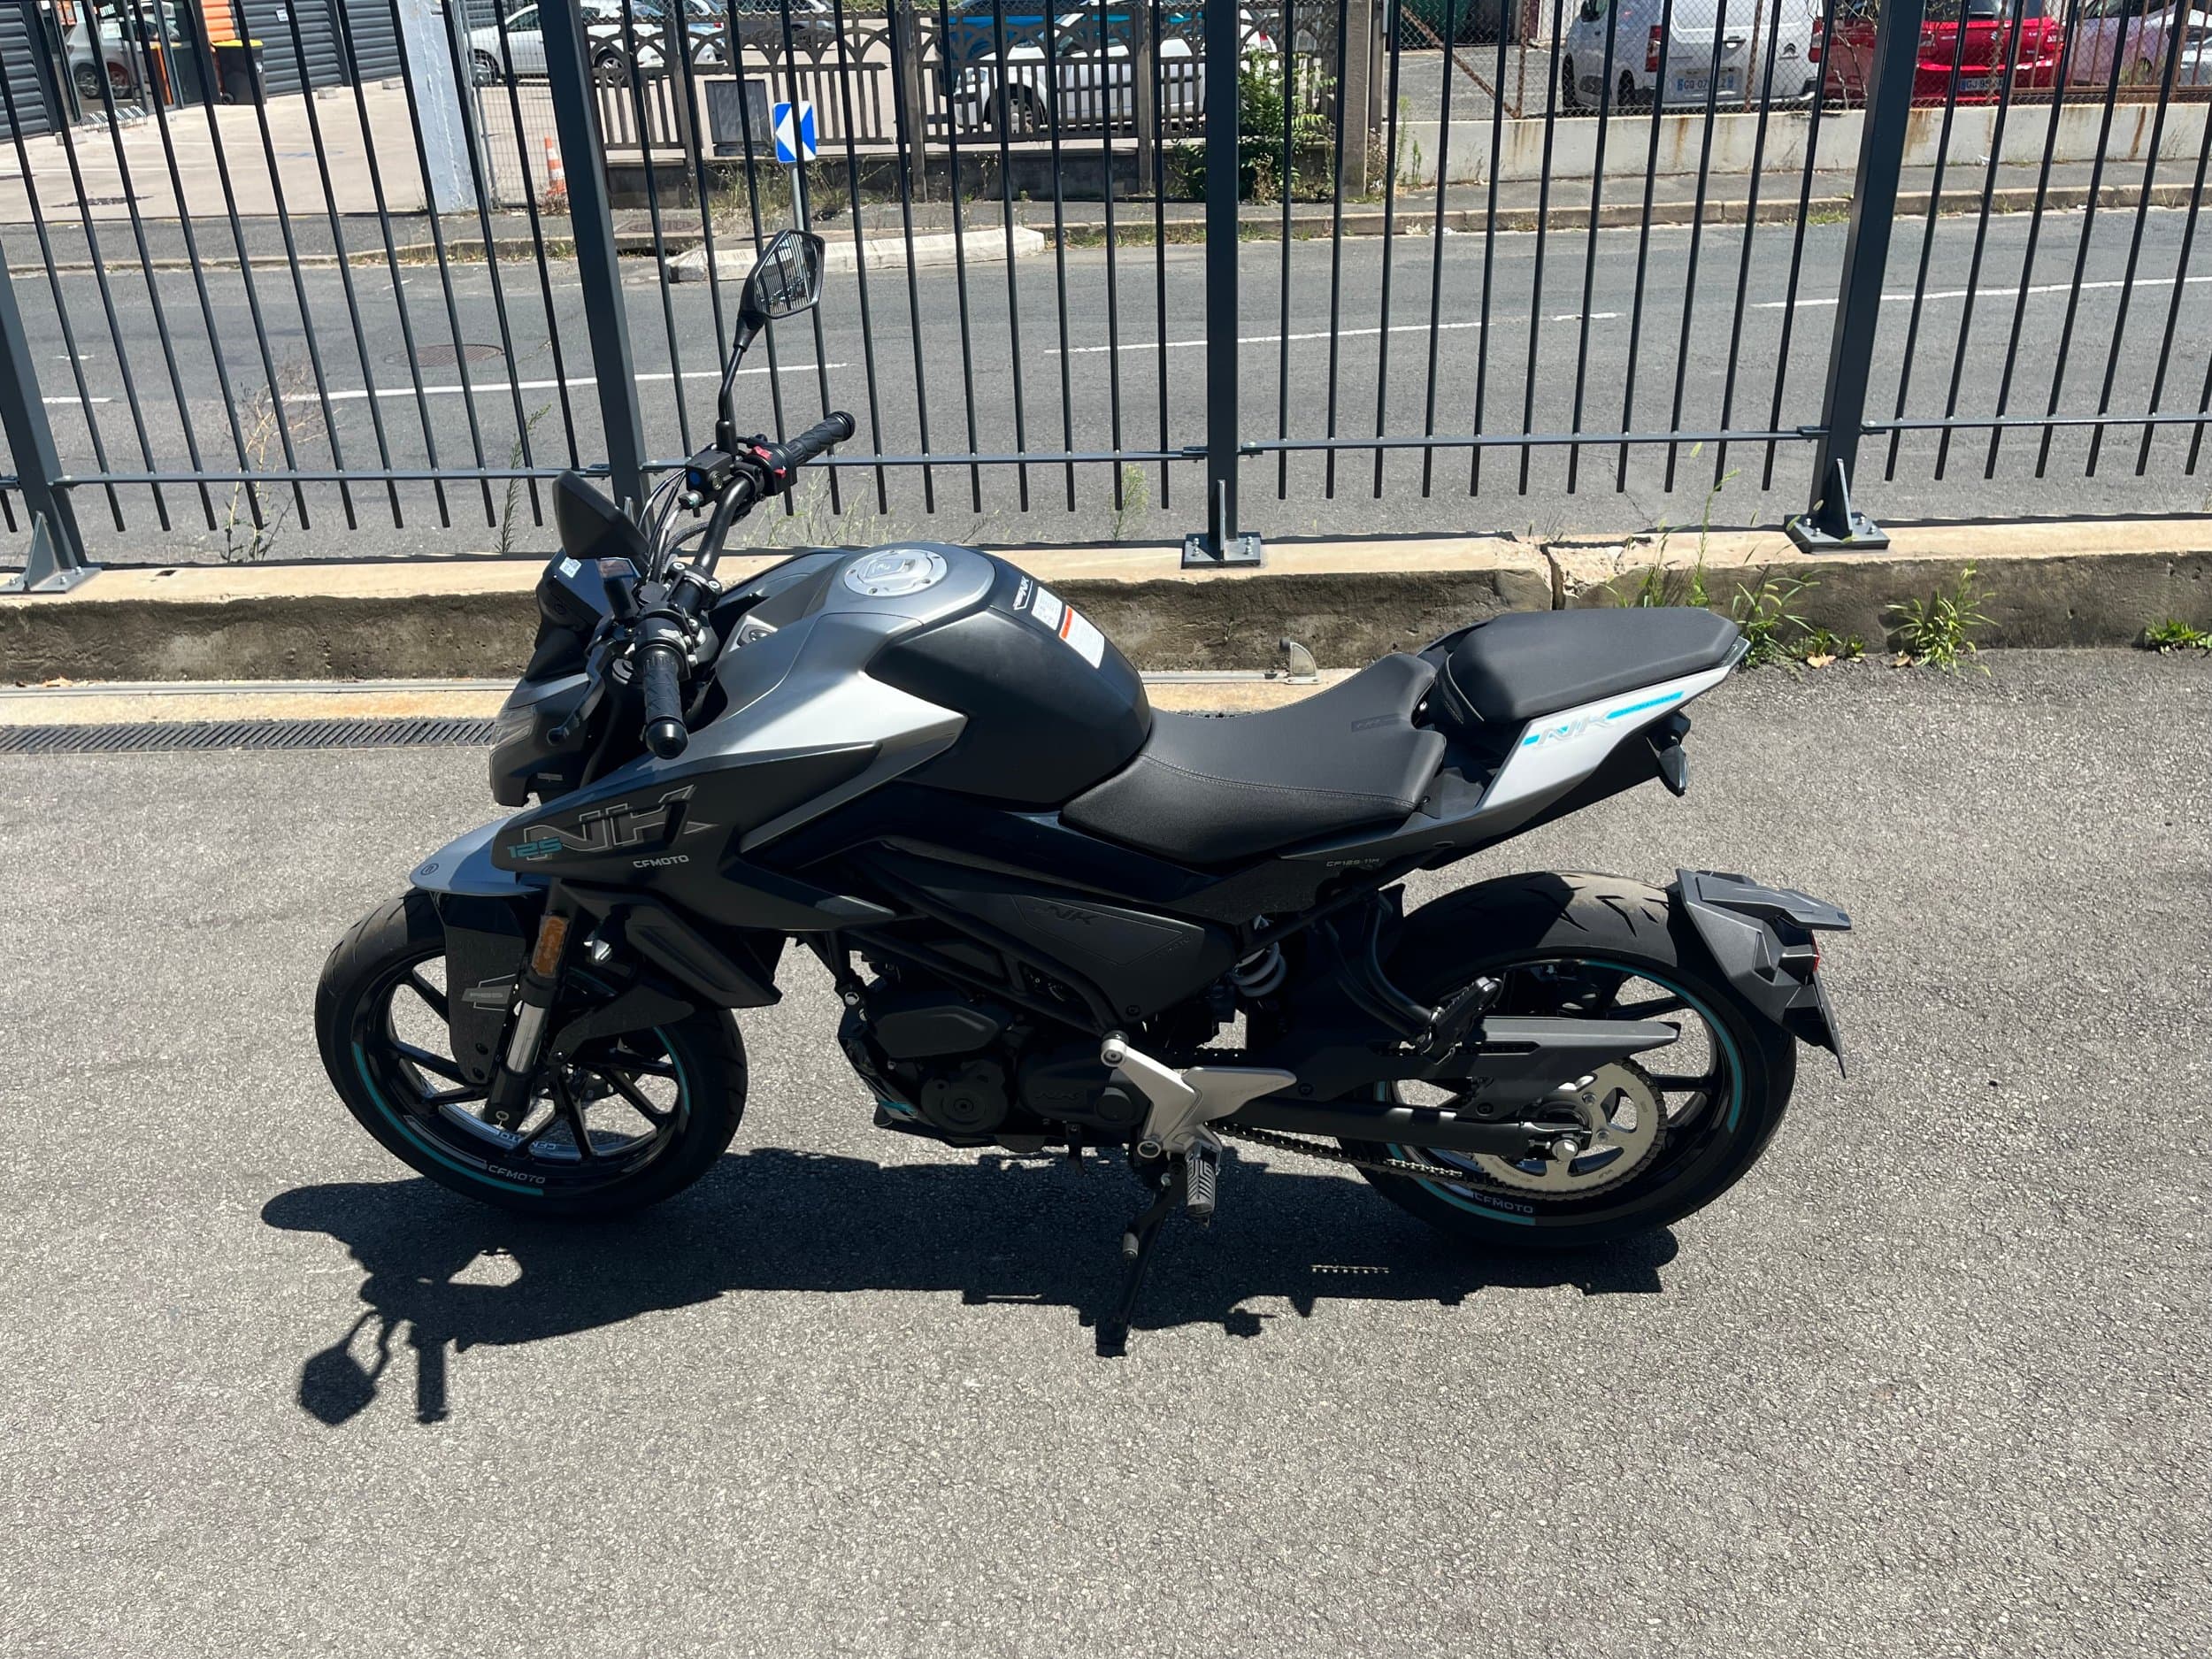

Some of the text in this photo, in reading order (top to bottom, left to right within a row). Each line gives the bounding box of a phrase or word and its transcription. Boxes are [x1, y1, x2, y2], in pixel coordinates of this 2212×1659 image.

[507, 837, 565, 858] 125
[633, 854, 689, 869] CFMOTO
[488, 1164, 546, 1184] CFMOTO
[1475, 1193, 1533, 1214] CFMOTO
